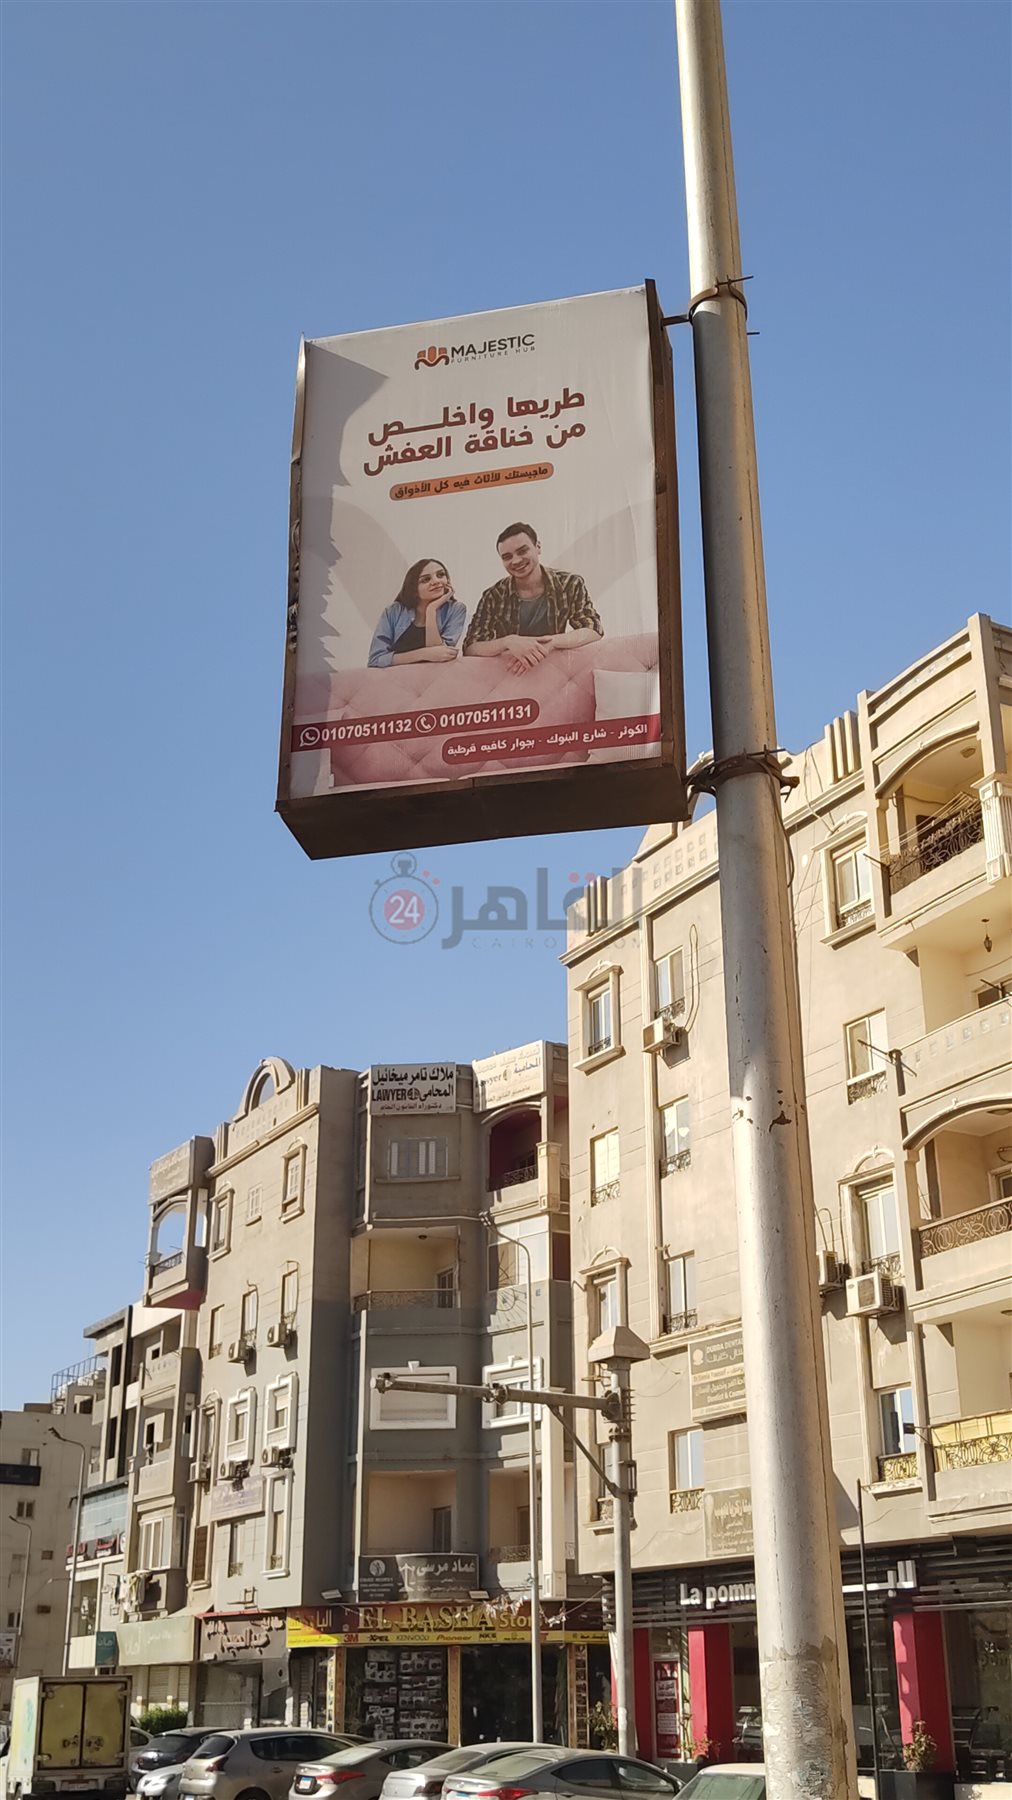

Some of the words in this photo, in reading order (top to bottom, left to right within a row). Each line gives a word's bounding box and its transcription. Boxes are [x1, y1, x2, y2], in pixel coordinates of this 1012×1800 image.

[451, 334, 535, 358] MAJESTIC
[451, 351, 508, 364] FURNITURE
[515, 346, 535, 354] HUB
[507, 388, 585, 419] طريها
[464, 425, 533, 454] خناقة
[546, 421, 586, 449] من
[363, 436, 452, 477] العفش
[434, 480, 449, 494] كل
[453, 477, 470, 489] فيه
[474, 472, 501, 485] للأثاث
[394, 483, 431, 499] الأذواق
[439, 704, 532, 728] 01070511131
[321, 719, 412, 742] 01070511132
[546, 732, 579, 745] البنوك
[582, 728, 607, 743] شارع
[617, 724, 648, 739] الكوثر
[447, 742, 476, 756] قرطبة
[480, 740, 507, 753] كافيه
[510, 738, 535, 751] بجوار
[372, 1067, 408, 1086] ميخائيل
[408, 1067, 428, 1086] تامر
[372, 1088, 407, 1102] LAWYER
[680, 1583, 703, 1606] La
[705, 1583, 756, 1610] pomm
[358, 1606, 392, 1629] EL
[400, 1606, 494, 1630] BASHA
[344, 1634, 359, 1643] 3M
